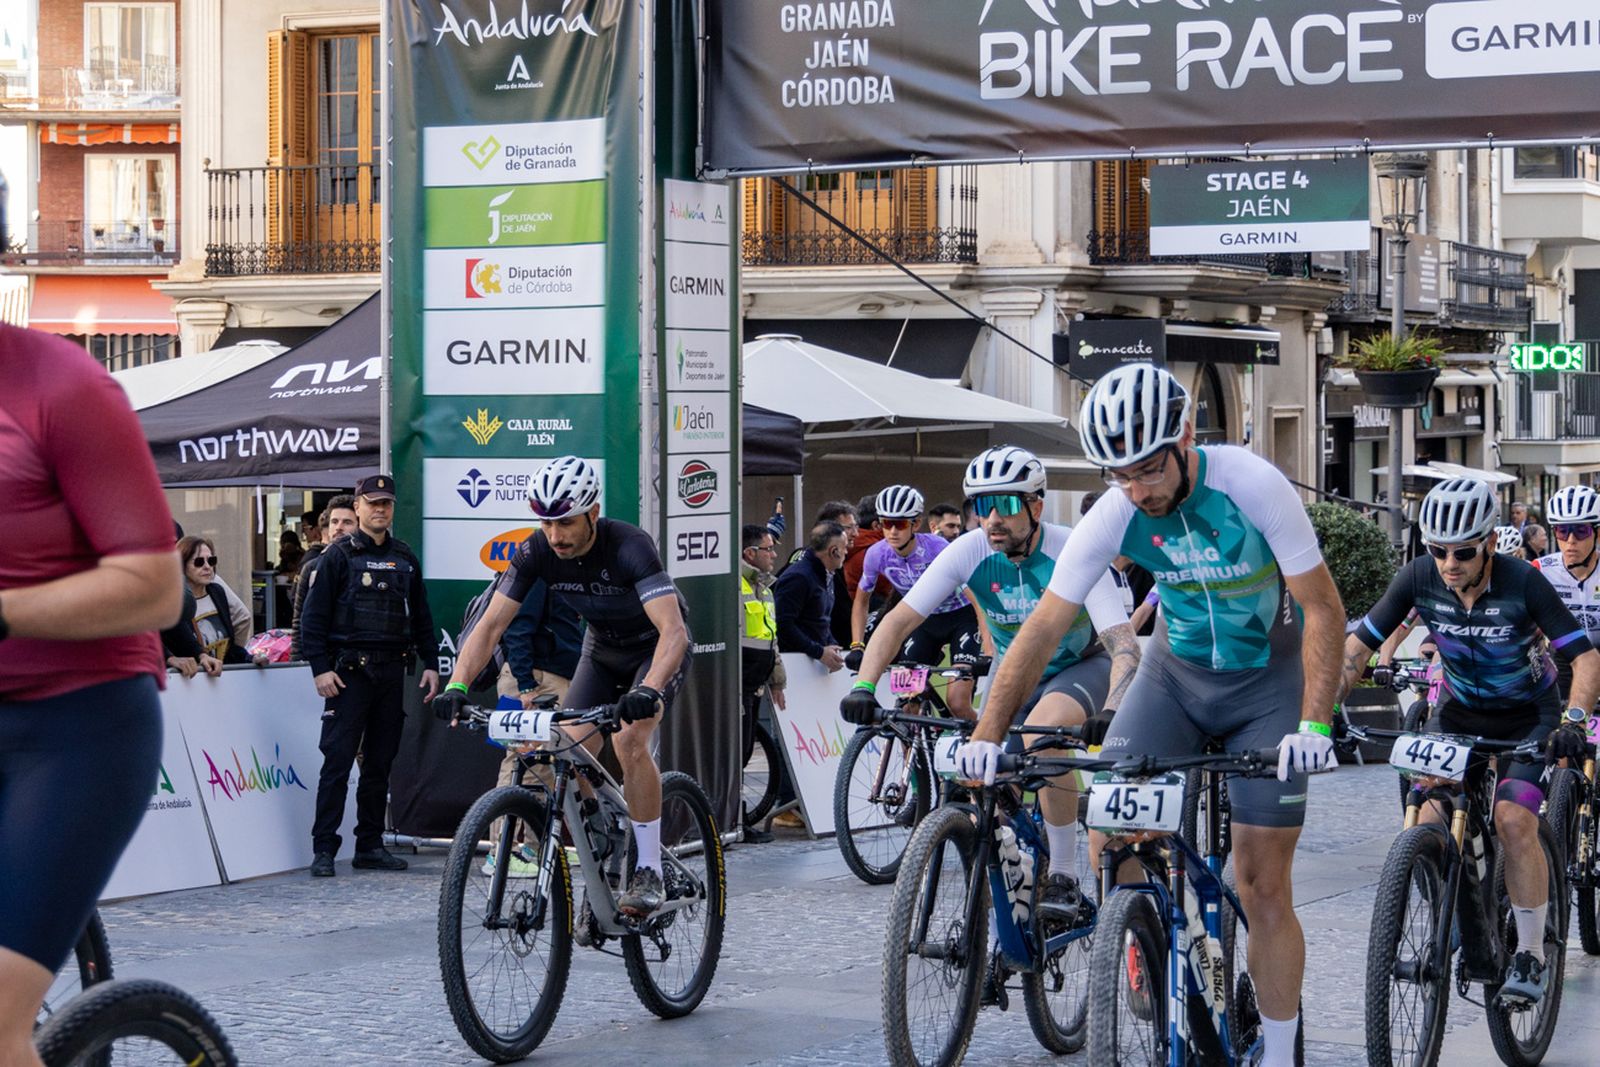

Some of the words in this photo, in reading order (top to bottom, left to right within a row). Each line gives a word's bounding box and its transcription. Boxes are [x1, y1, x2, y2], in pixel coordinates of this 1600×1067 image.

[433, 0, 598, 47] Andalucía
[781, 0, 895, 33] GRANADA
[1451, 20, 1600, 52] GARMI
[805, 34, 869, 70] JAÉN
[979, 24, 1151, 100] BIKE
[1176, 9, 1404, 91] RACE
[1408, 13, 1425, 24] BY
[782, 73, 895, 108] CÓRDOBA
[505, 142, 573, 159] Diputación
[505, 159, 521, 171] de
[524, 156, 577, 170] Granada
[1206, 170, 1286, 192] STAGE
[1292, 169, 1309, 189] 4
[502, 212, 553, 222] DIPUTACIÓN
[1227, 195, 1290, 218] JAÉN
[502, 224, 513, 233] DE
[515, 223, 536, 233] JAÉN
[1219, 231, 1298, 246] GARMIN
[508, 265, 573, 281] Diputación
[508, 282, 523, 294] de
[526, 281, 573, 294] Córdoba
[670, 275, 725, 297] GARMIN
[446, 337, 587, 366] GARMIN
[507, 419, 535, 432] CAJA
[537, 418, 573, 431] RURAL
[683, 404, 714, 431] Jaén
[527, 431, 555, 446] JAÉN
[1153, 561, 1252, 584] PREMIUM
[499, 711, 541, 735] 44-1
[1405, 739, 1457, 773] 44-2
[202, 742, 308, 802] Andalucía
[1105, 787, 1165, 824] 45-1
